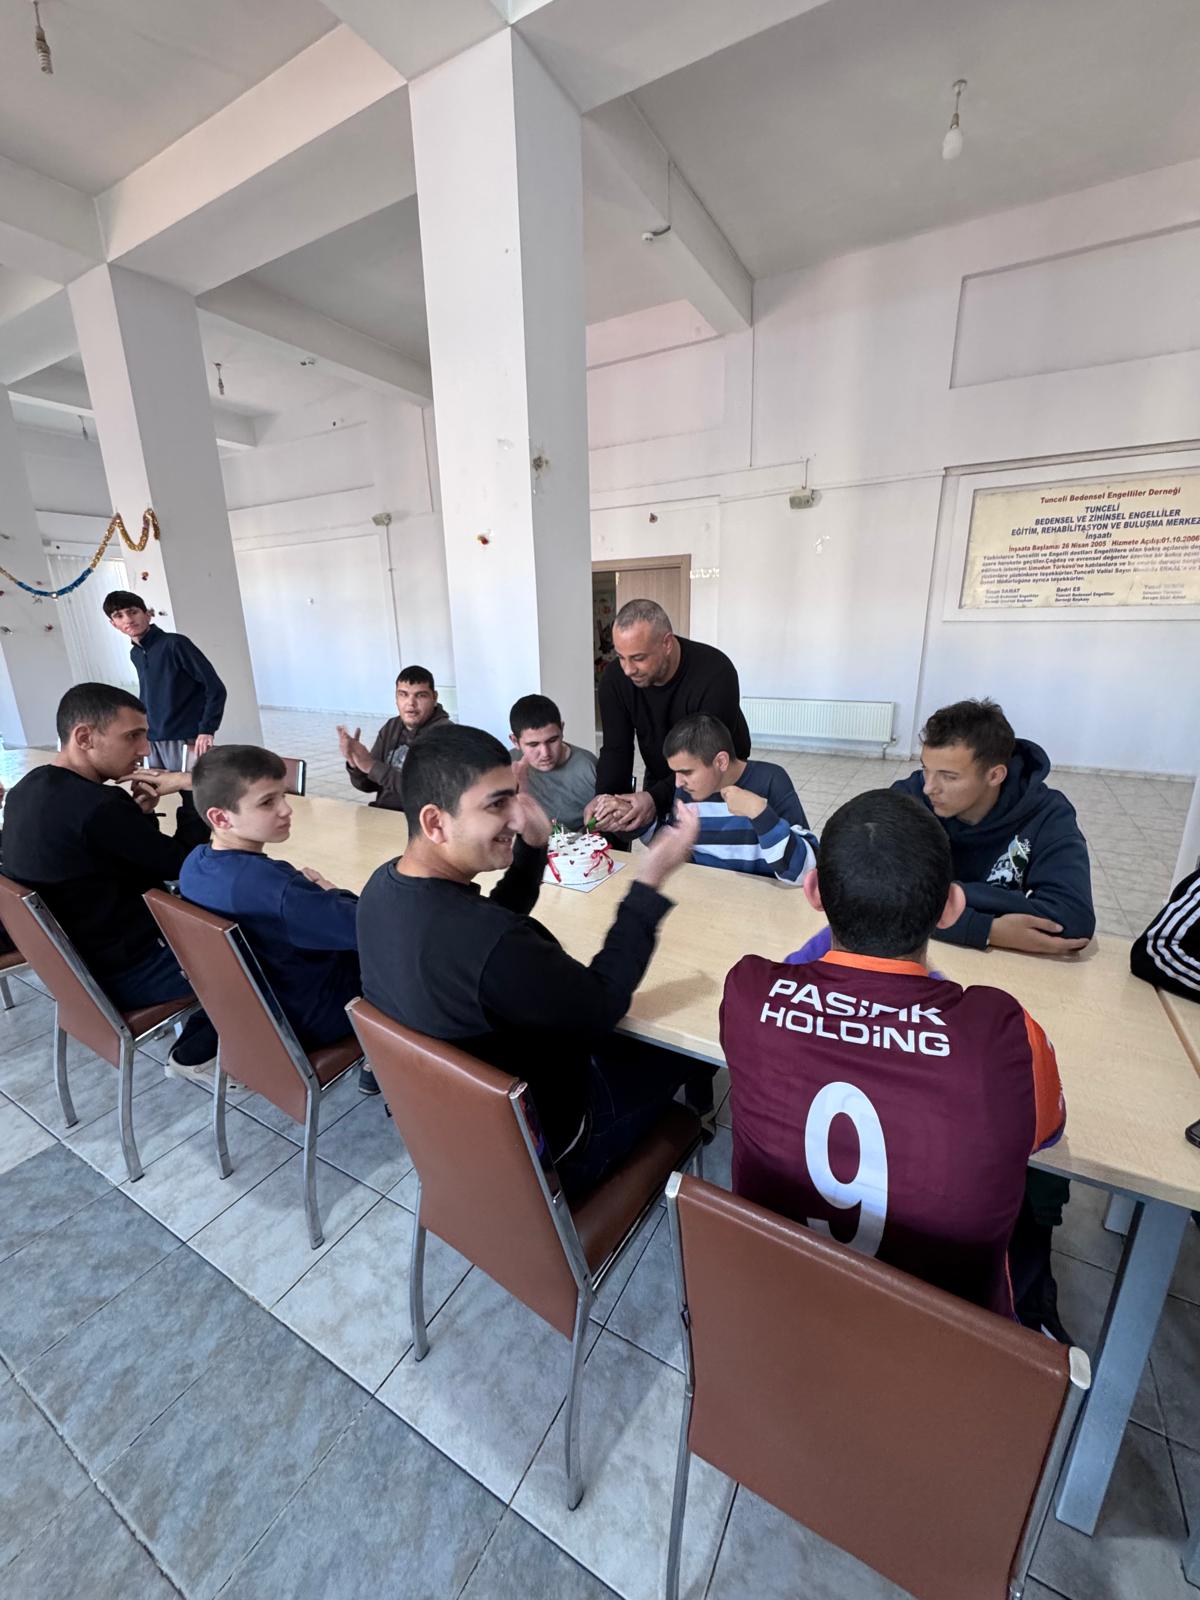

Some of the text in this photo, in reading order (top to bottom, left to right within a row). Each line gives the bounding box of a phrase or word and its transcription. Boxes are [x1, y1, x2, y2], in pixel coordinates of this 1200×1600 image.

[1040, 487, 1181, 504] Tunceli Bedensel Engelliler Derneği
[1035, 508, 1181, 526] BEDENSEL VE ZİHİNSEL ENGELLİLER
[1085, 502, 1120, 514] TUNCELİ
[1011, 526, 1039, 536] EĞİTİM,
[1111, 521, 1122, 530] VE
[1123, 518, 1164, 529] BULUŞMA
[805, 1081, 888, 1257] 9
